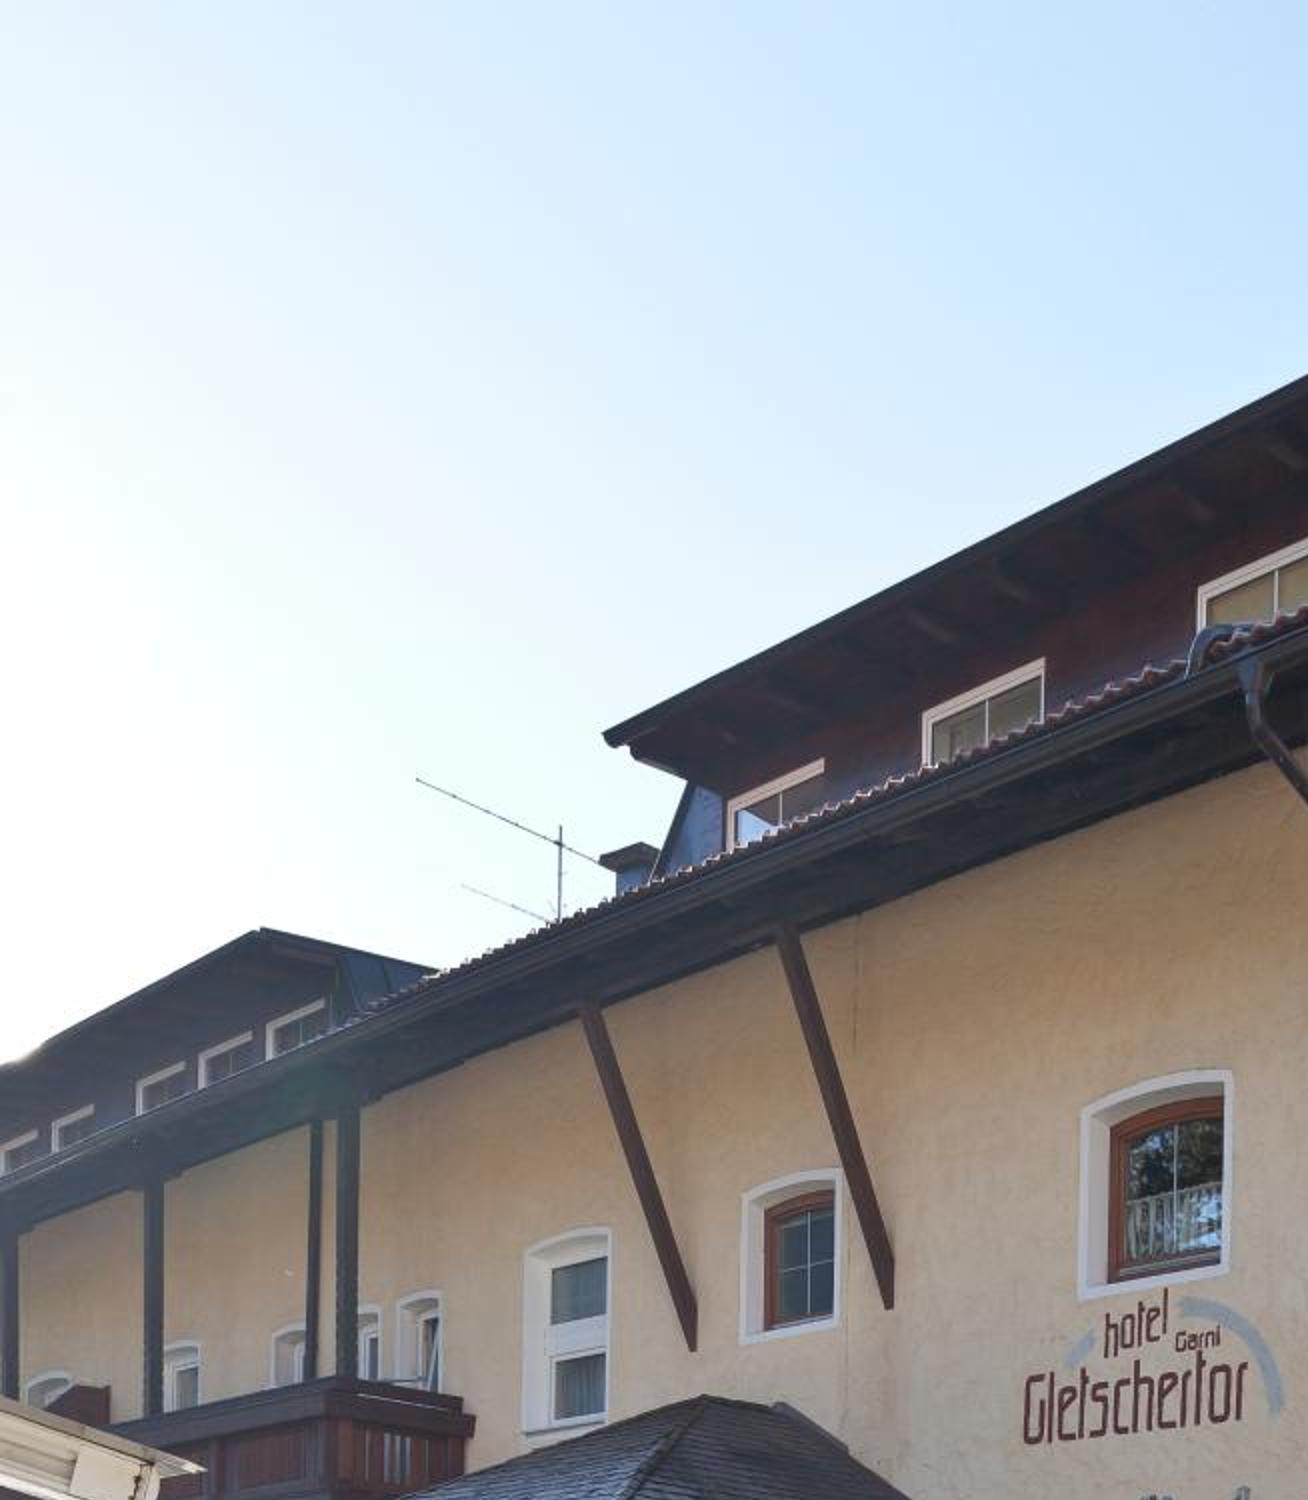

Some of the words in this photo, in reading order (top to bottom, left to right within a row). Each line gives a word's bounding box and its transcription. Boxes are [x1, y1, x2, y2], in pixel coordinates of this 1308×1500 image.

[1103, 1287, 1168, 1358] hotel
[1175, 1325, 1221, 1352] Garni
[1023, 1350, 1249, 1445] Gletschertor
